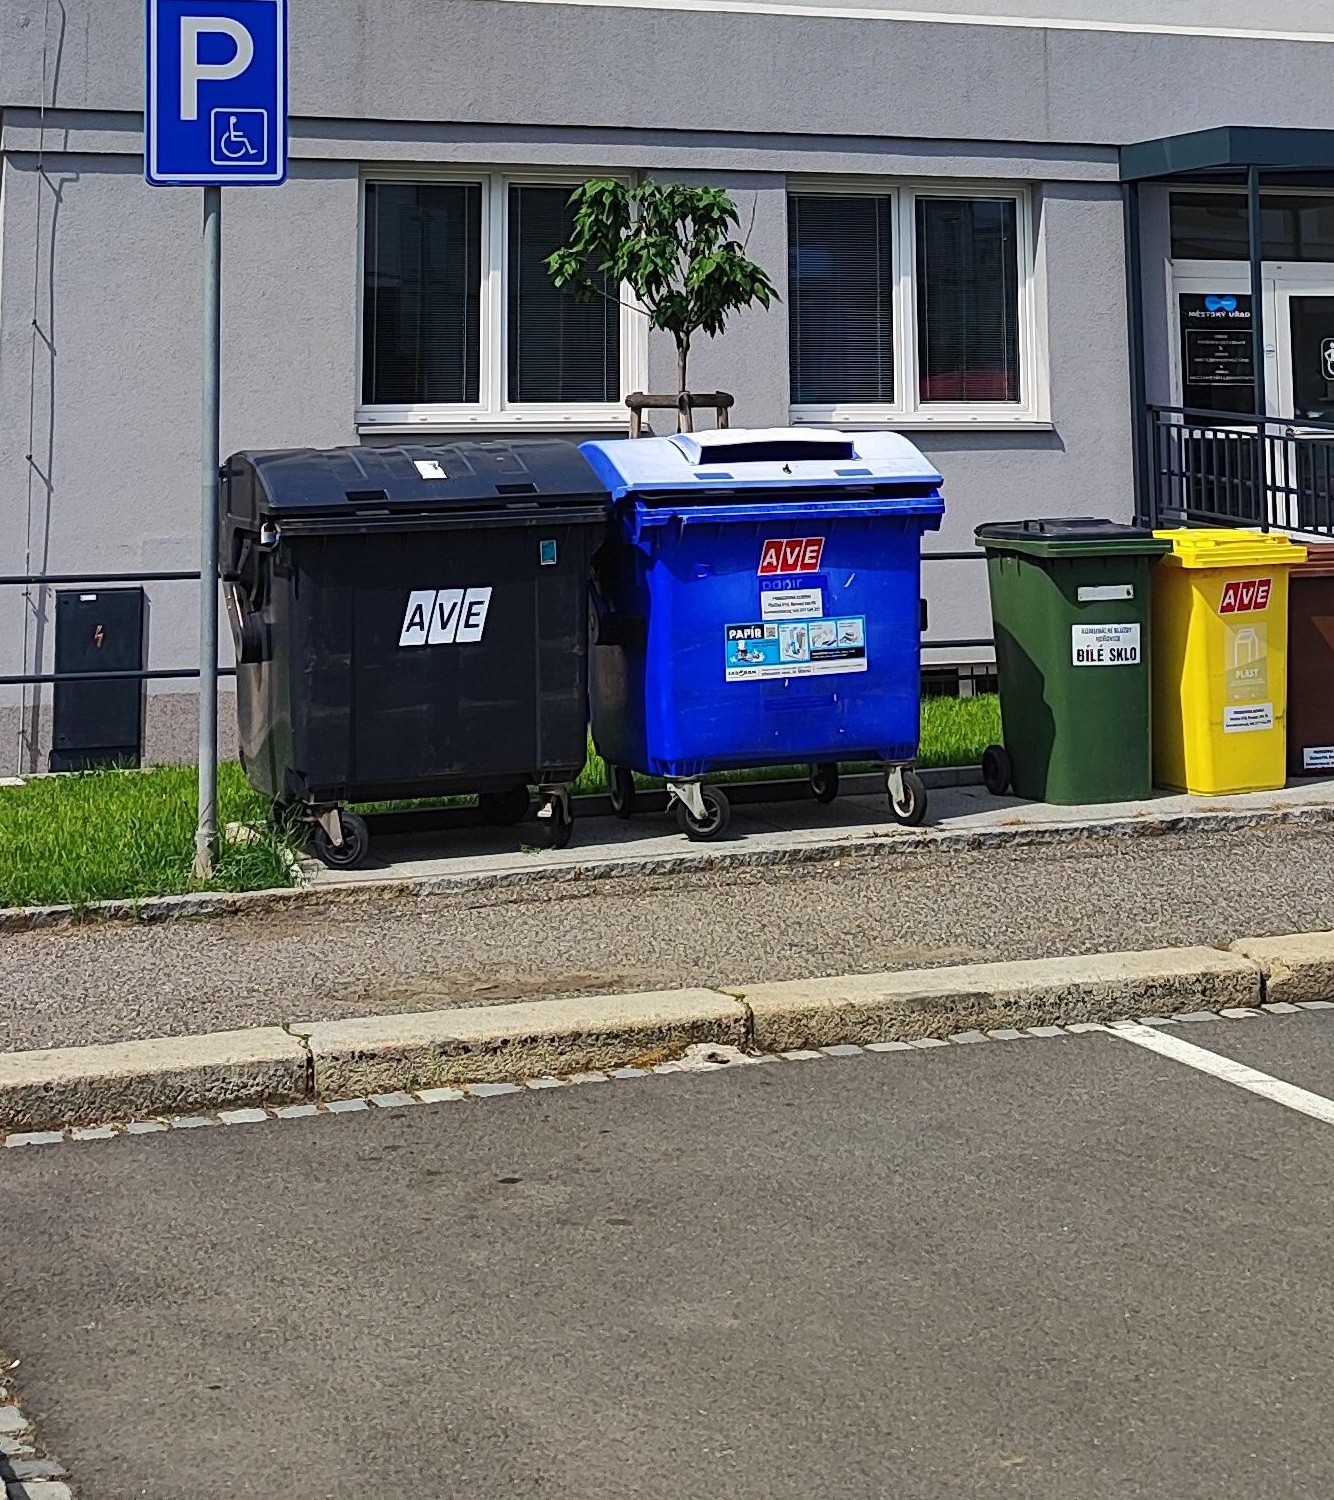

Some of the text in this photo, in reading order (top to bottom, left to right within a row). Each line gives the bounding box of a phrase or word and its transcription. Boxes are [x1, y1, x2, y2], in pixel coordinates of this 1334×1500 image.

[180, 16, 254, 120] P
[762, 545, 819, 567] AVE
[1221, 586, 1269, 607] AVE
[405, 600, 485, 632] AVE
[728, 626, 762, 640] PAPÍR
[1077, 644, 1137, 662] BÍLÉ SKLO
